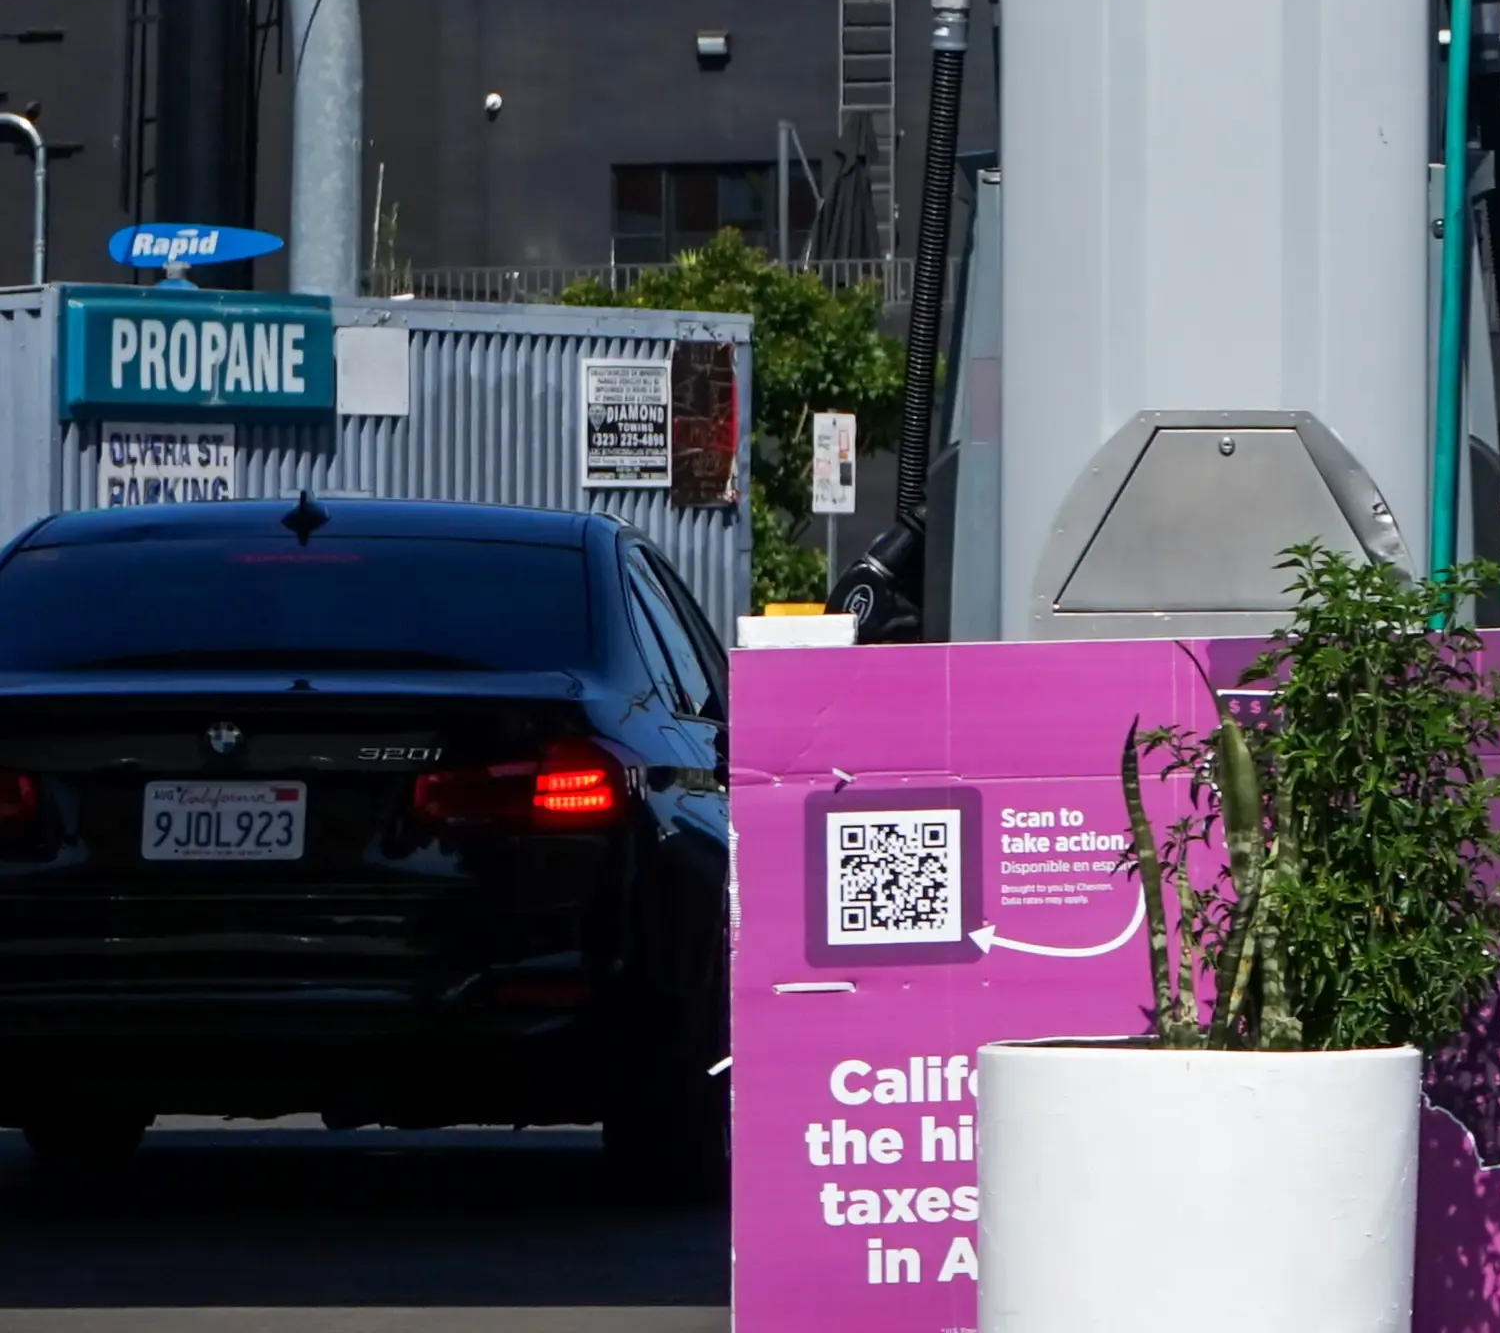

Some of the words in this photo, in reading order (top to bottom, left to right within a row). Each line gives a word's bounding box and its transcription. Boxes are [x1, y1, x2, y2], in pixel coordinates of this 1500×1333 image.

[132, 229, 220, 263] Rapid
[111, 317, 305, 393] PROPANE
[606, 404, 665, 423] DIAMOND
[617, 422, 655, 432] TOWING
[108, 433, 192, 468] OLVERA
[197, 434, 228, 467] ST.
[592, 433, 618, 446] (323)
[153, 790, 175, 801] AUG
[177, 786, 275, 810] California
[152, 811, 294, 849] 9JOL923
[1001, 808, 1055, 828] Scan
[1060, 807, 1084, 827] to
[1001, 833, 1050, 853] take
[1056, 831, 1130, 852] action.
[1001, 859, 1070, 876] Disponible
[1073, 862, 1089, 872] en
[805, 1119, 904, 1166] the
[921, 1115, 978, 1162] hi
[820, 1183, 979, 1226] taxes
[868, 1238, 921, 1284] in
